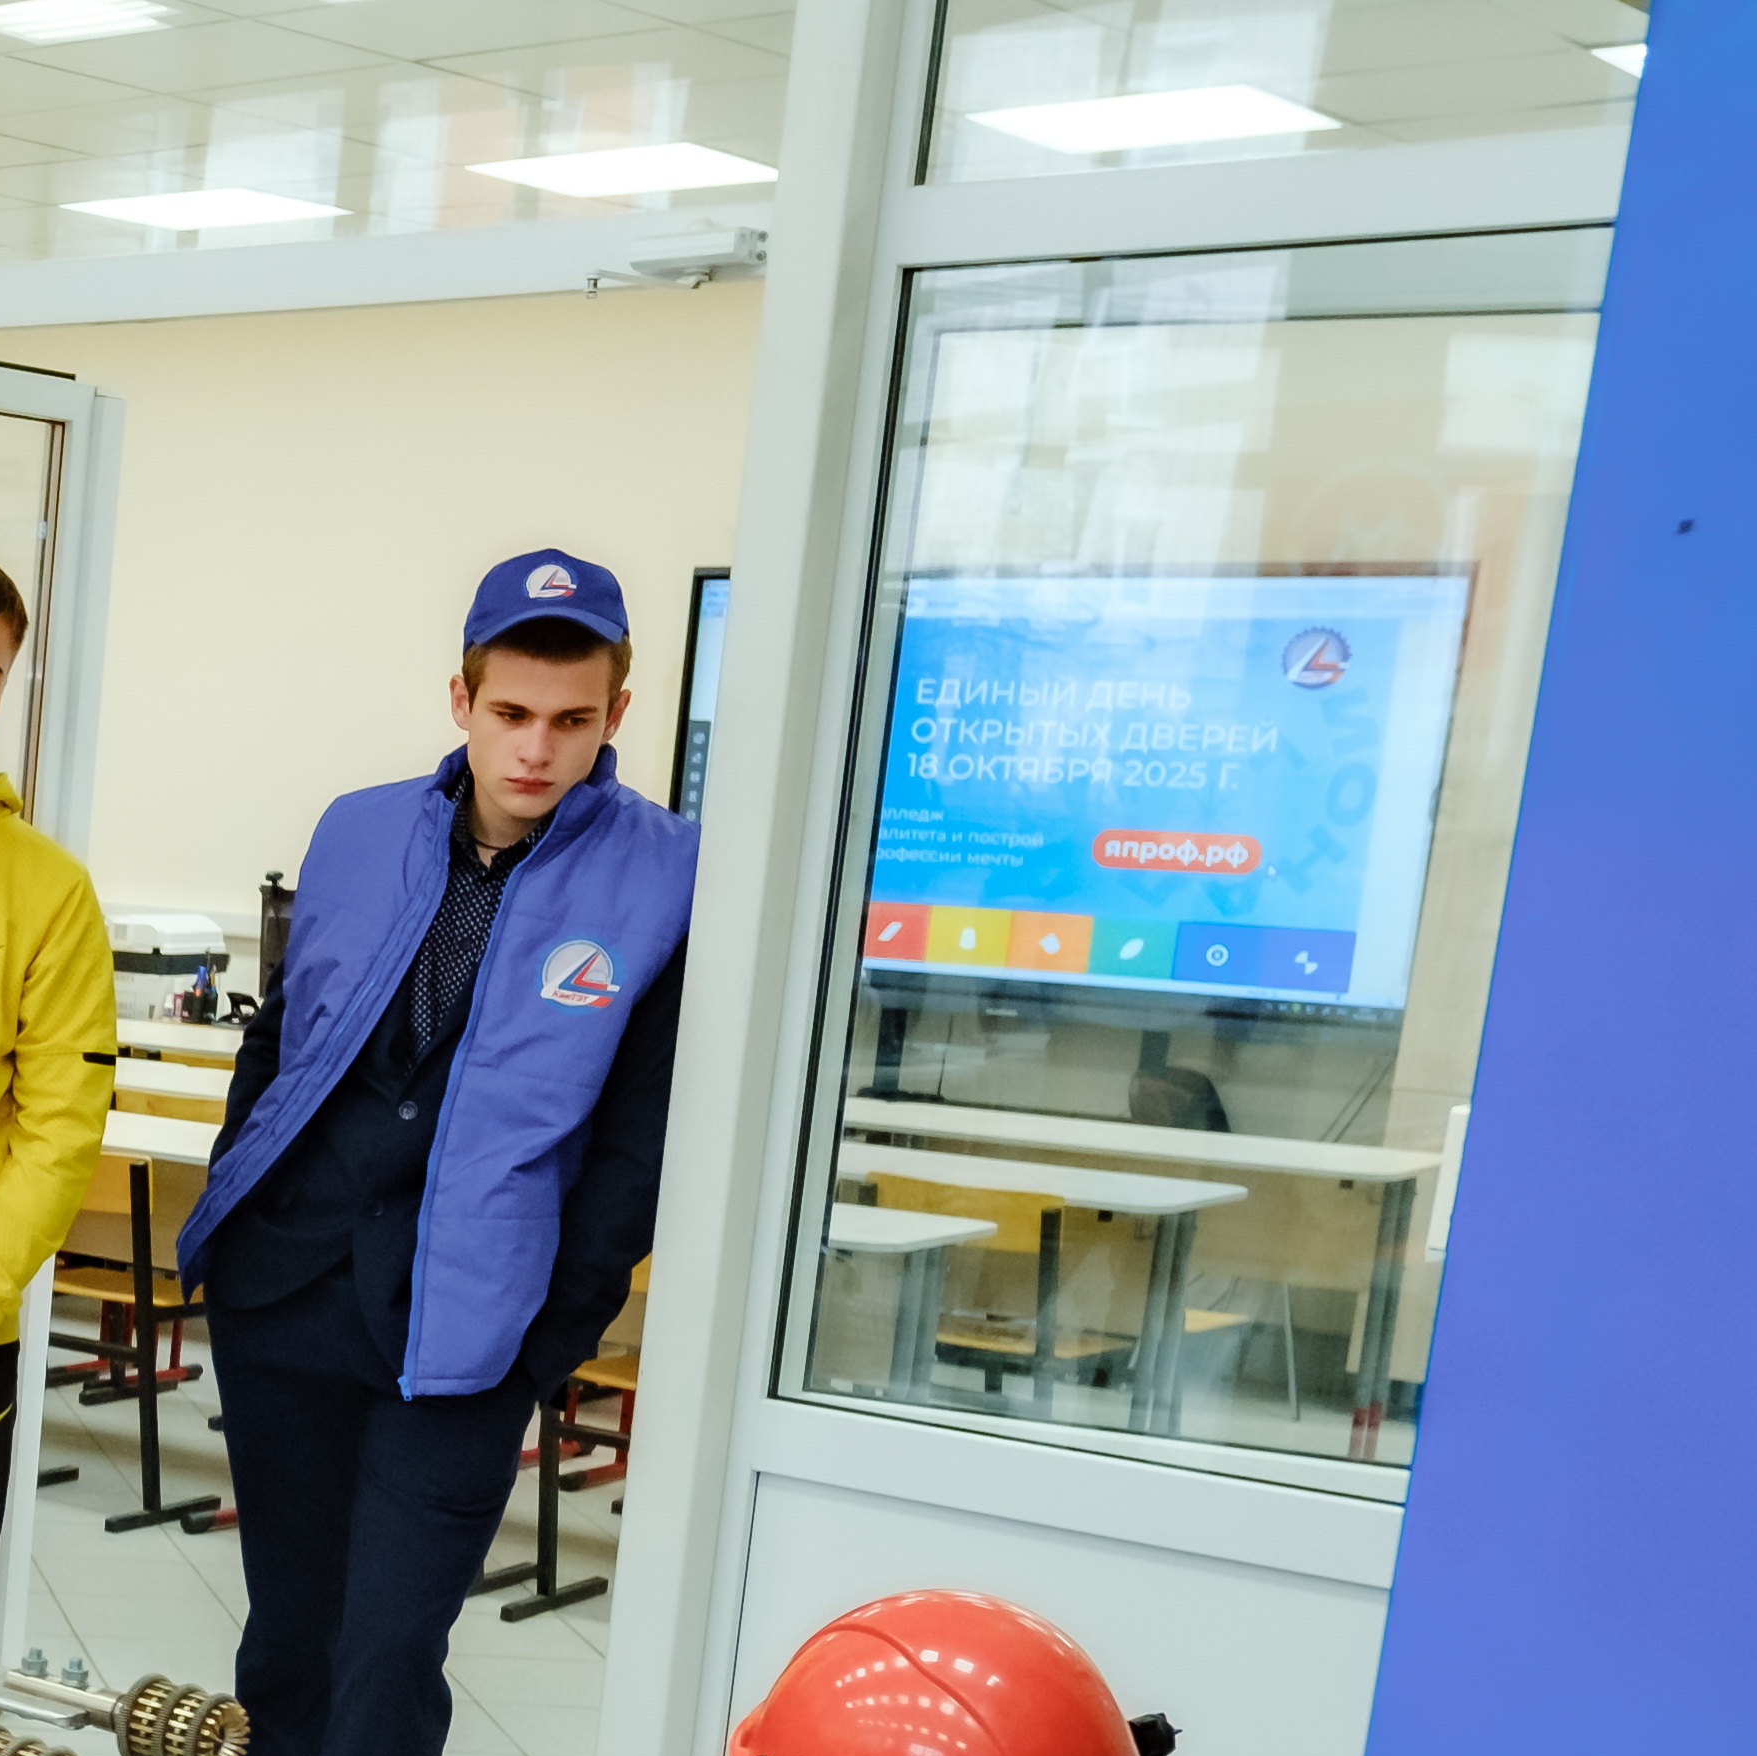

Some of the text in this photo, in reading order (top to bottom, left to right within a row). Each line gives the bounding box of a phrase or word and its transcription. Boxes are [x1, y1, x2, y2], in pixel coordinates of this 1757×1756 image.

[915, 674, 1192, 713] ЕДИНЫЙ ДЕНЬ
[911, 716, 1280, 755] ОТКРЫТЫХ ДВЕРЕЙ
[907, 752, 1241, 791] 18 ОКТЯБРЯ 2025 Г.
[1104, 838, 1249, 868] япроф.рф
